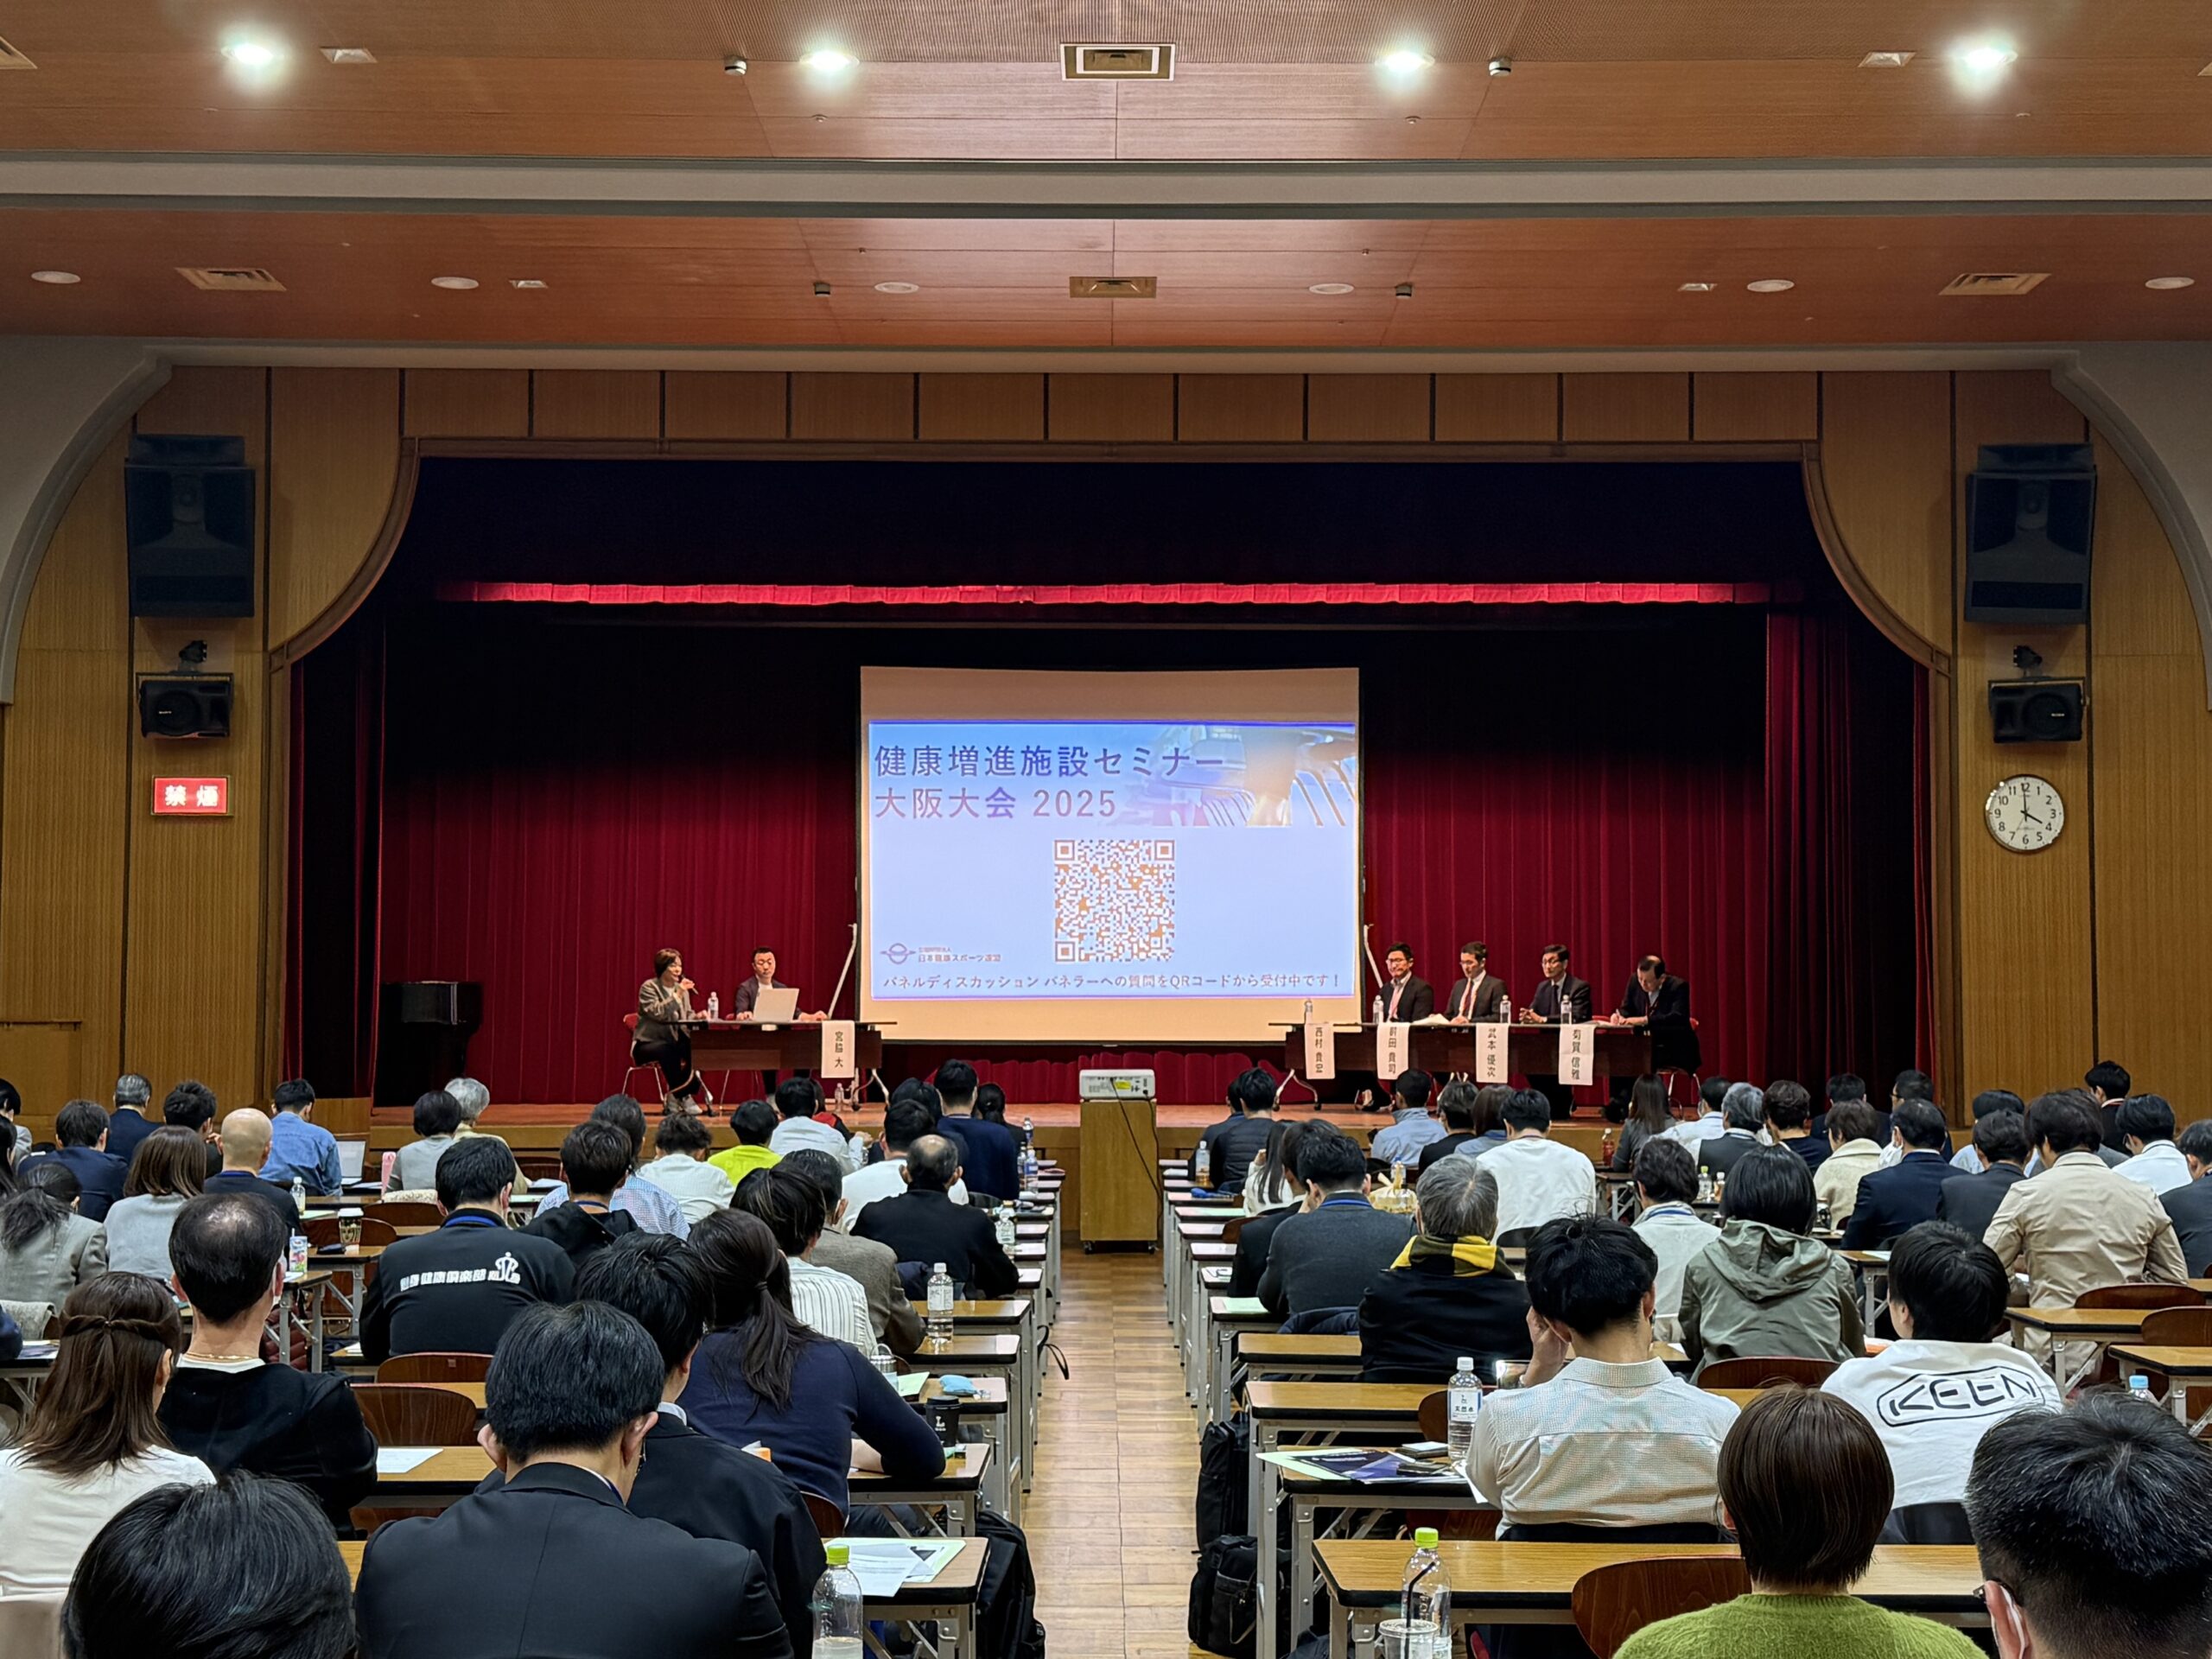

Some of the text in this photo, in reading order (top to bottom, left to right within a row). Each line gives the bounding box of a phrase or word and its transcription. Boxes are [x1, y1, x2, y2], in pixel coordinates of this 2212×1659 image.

[874, 745, 1223, 777] 健康増進施設セミナー
[2009, 785, 2016, 795] 11
[875, 786, 1116, 819] 大阪大会 2025
[1998, 796, 2008, 805] 10
[2045, 795, 2052, 805] 2
[1994, 809, 2001, 818] 9
[2050, 809, 2056, 819] 3
[1999, 822, 2005, 831] 8
[2045, 823, 2052, 831] 4
[2009, 831, 2016, 841] 7
[2022, 834, 2029, 844] 6
[2036, 831, 2043, 842] 5
[1889, 1373, 2037, 1417] KEEN
